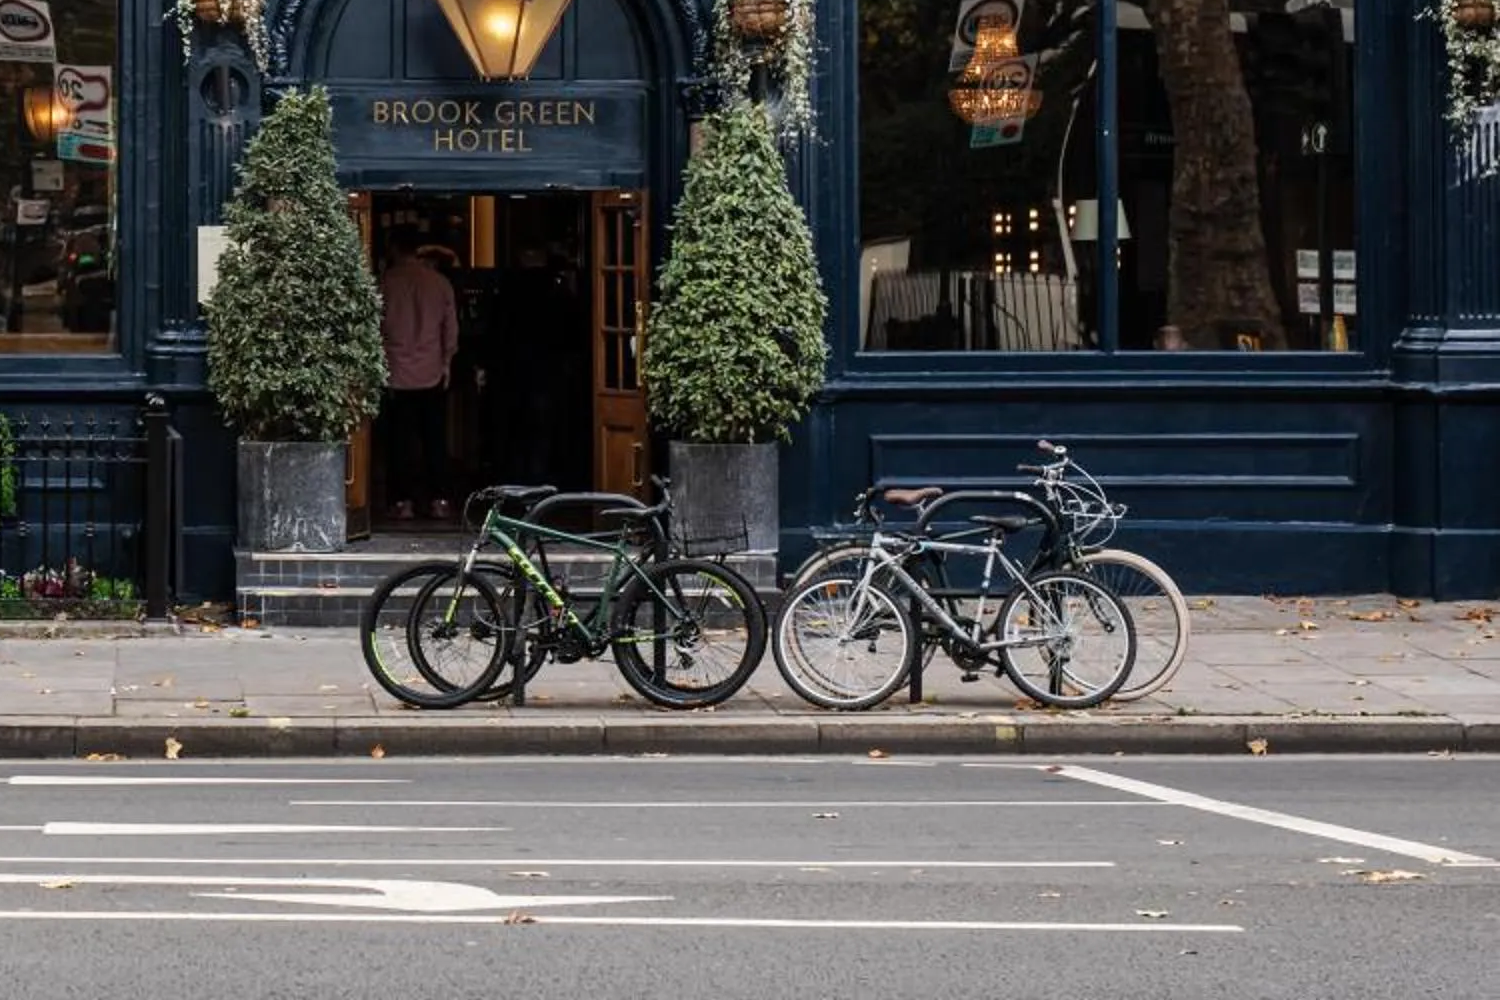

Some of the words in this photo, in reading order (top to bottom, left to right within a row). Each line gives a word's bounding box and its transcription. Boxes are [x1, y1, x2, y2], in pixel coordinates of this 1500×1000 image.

[373, 100, 482, 125] BROOK
[495, 100, 596, 126] GREEN
[434, 129, 533, 153] HOTEL
